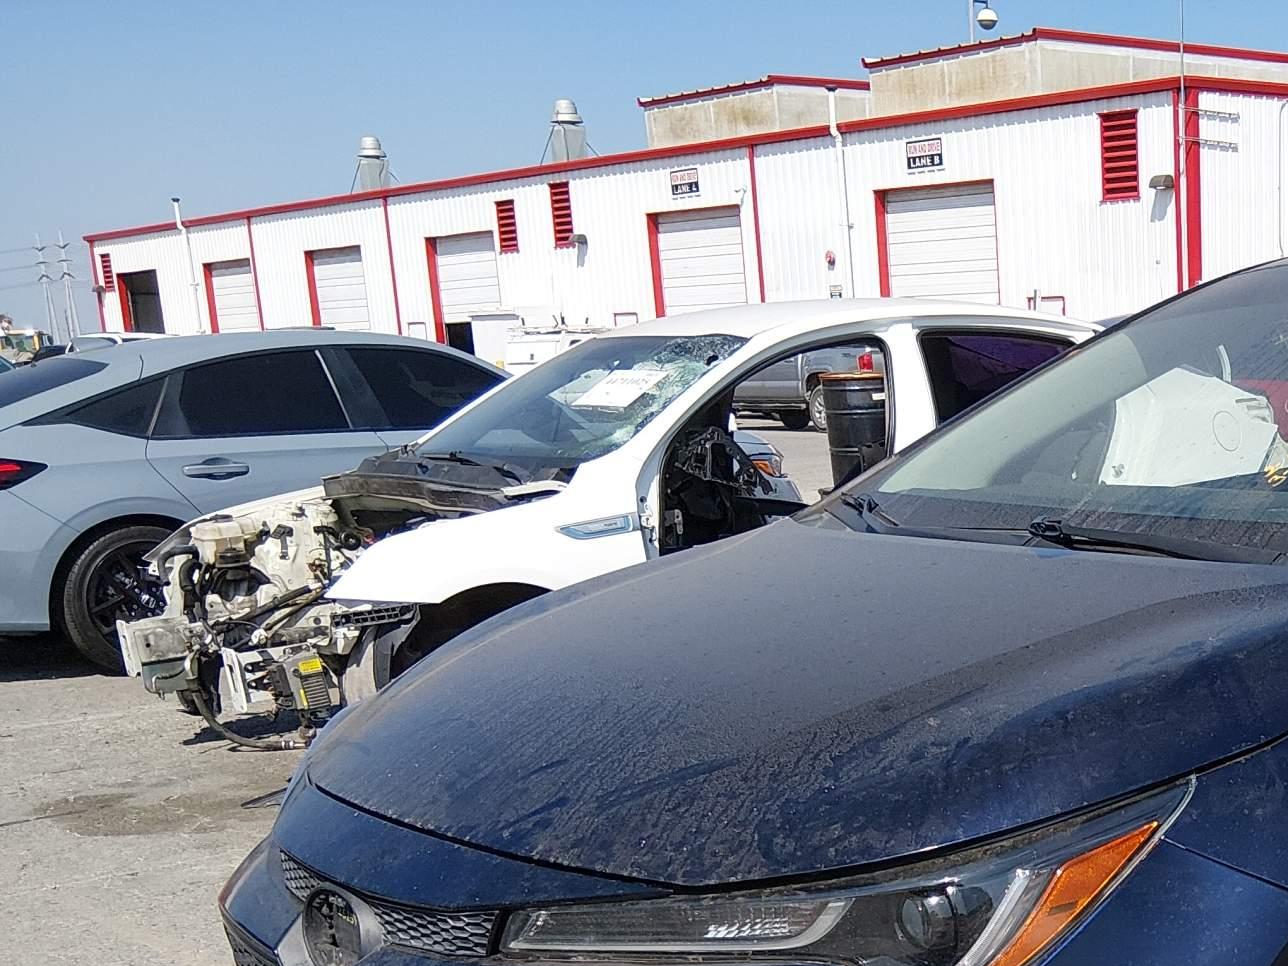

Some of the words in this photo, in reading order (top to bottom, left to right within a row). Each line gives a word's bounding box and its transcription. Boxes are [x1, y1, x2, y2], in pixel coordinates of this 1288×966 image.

[910, 155, 933, 168] LANE
[934, 155, 941, 165] B
[673, 184, 691, 194] LANE
